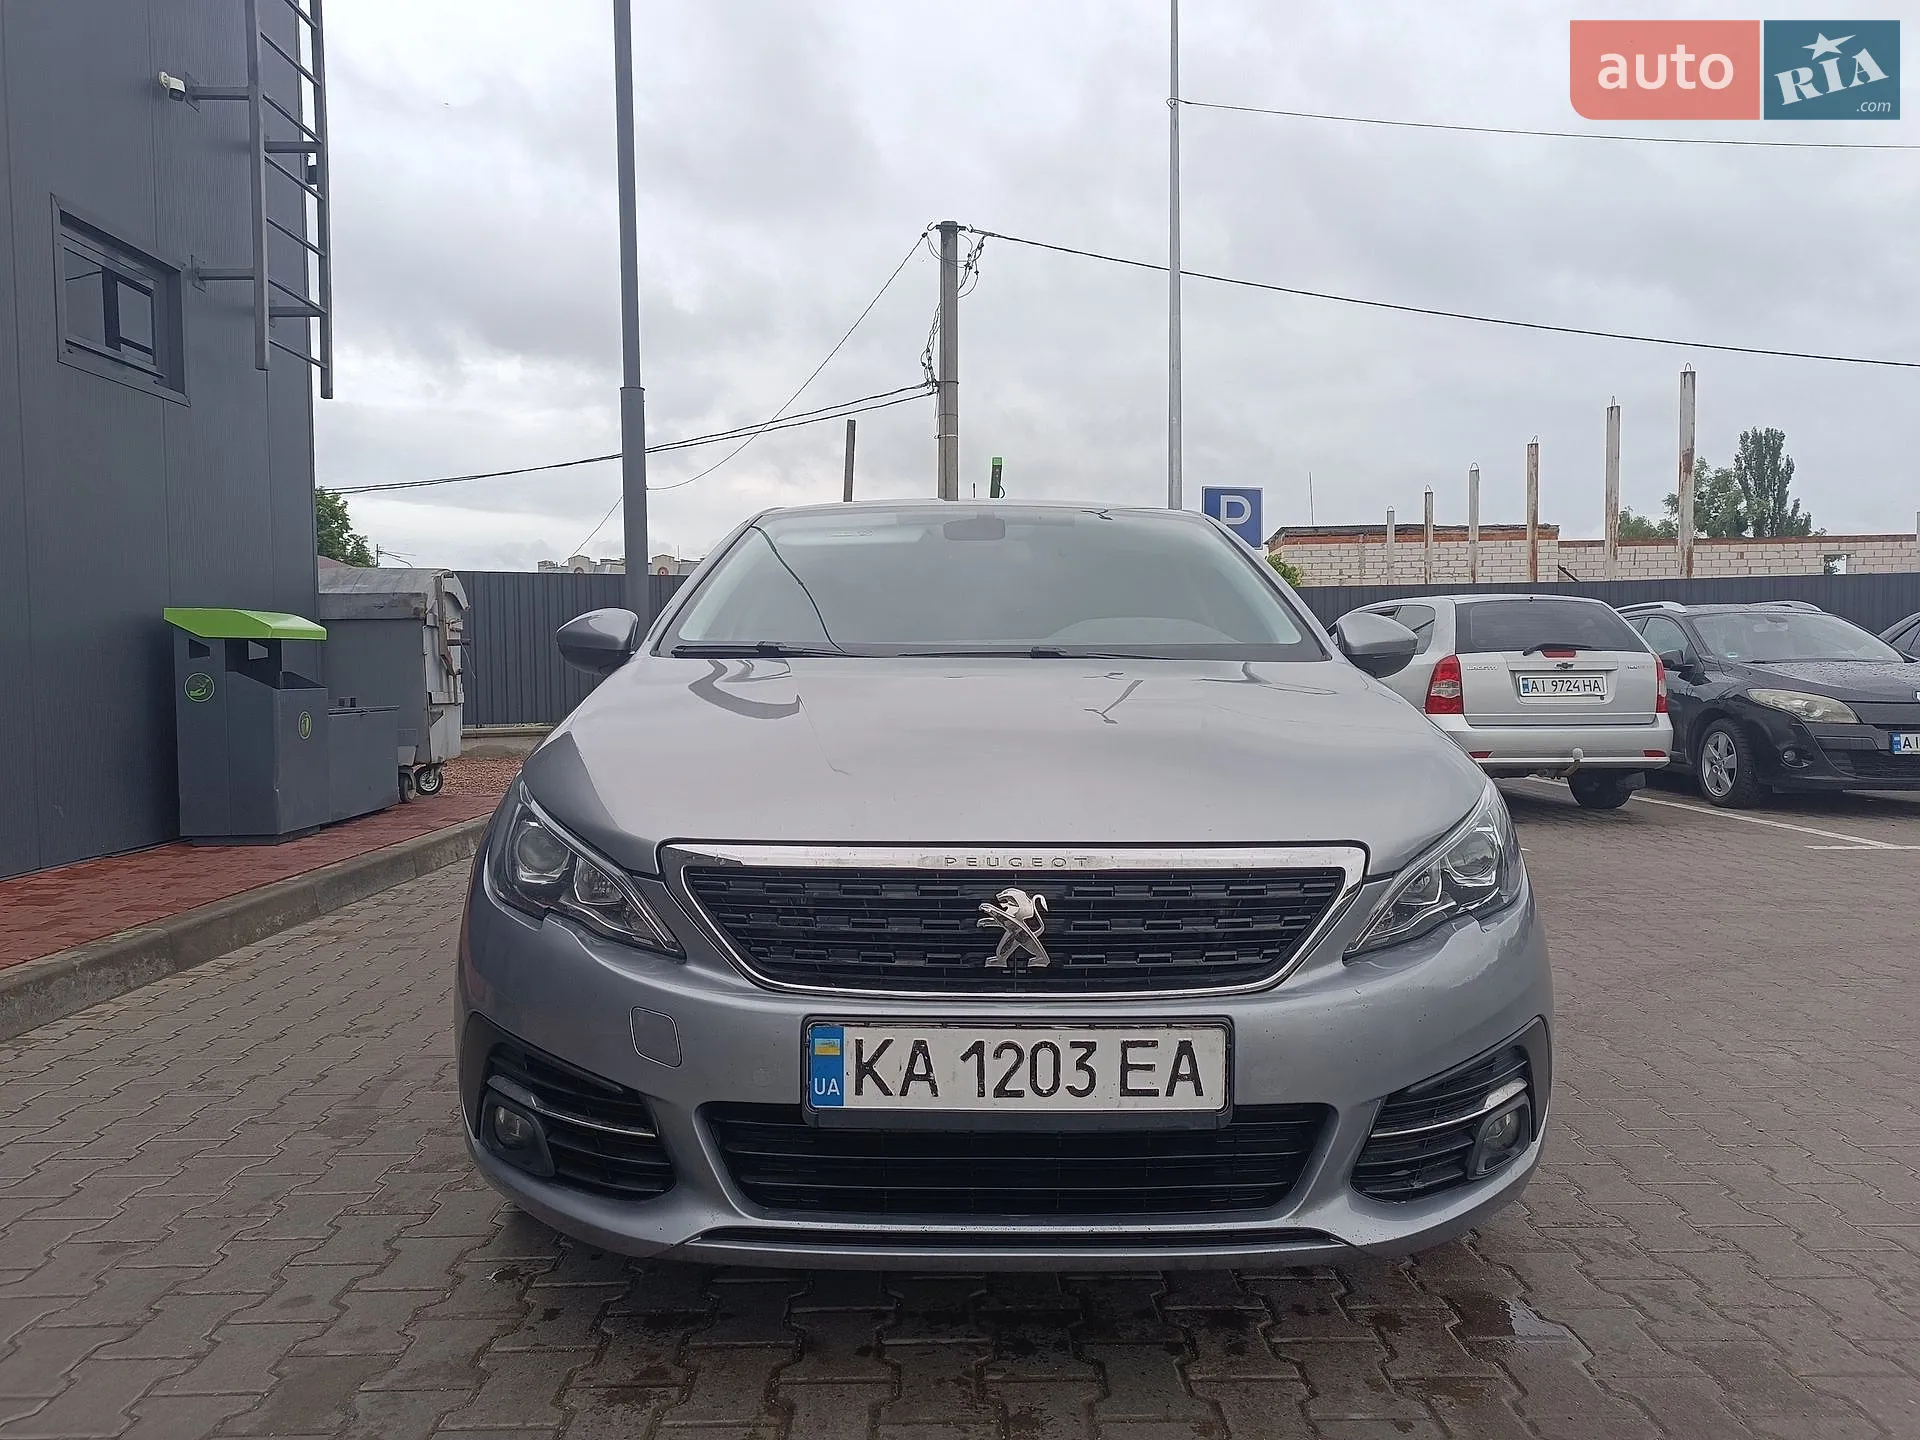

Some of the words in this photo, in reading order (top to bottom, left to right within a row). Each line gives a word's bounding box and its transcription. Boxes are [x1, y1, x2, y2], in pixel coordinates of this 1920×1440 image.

[1550, 680, 1580, 692] 9724
[1583, 680, 1602, 692] HA
[944, 857, 1088, 867] PEUGEOT
[854, 1038, 940, 1097] KA
[960, 1039, 1098, 1098] 1203
[1119, 1039, 1205, 1097] EA
[813, 1077, 841, 1096] UA
